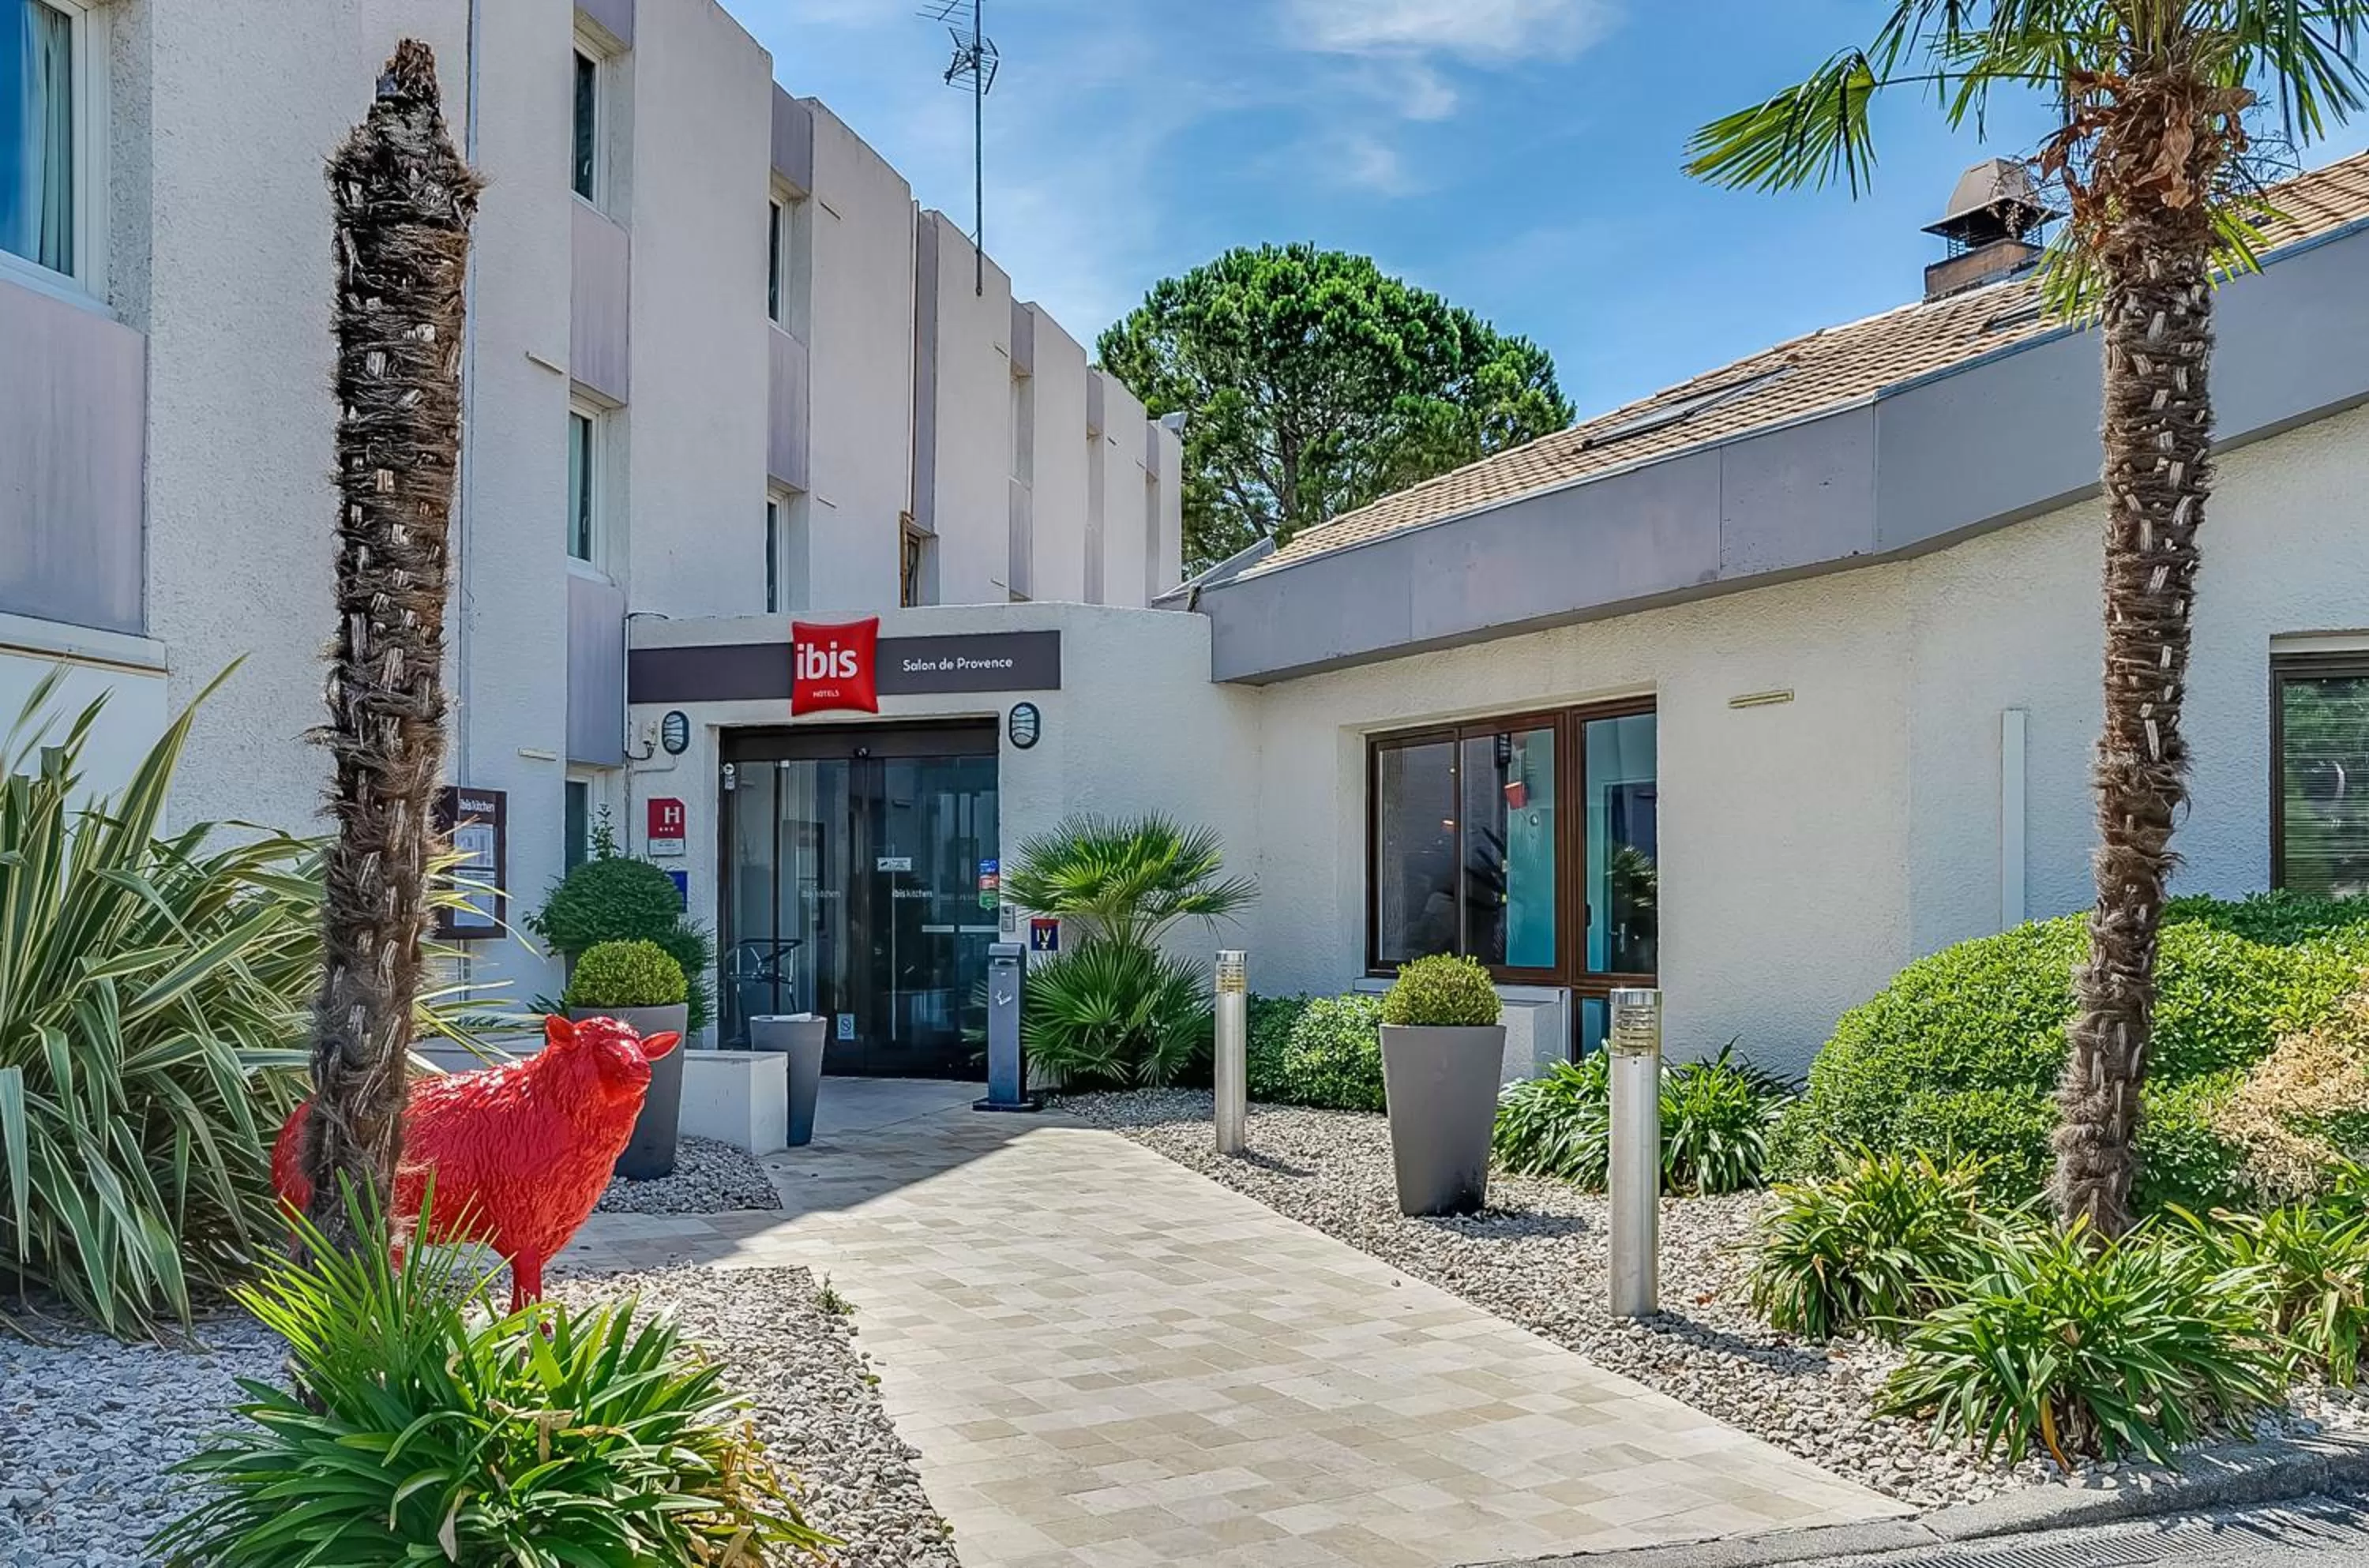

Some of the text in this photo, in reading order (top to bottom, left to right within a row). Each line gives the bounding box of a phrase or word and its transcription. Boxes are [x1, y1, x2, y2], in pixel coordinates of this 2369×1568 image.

[797, 641, 858, 680] ibis
[903, 656, 1013, 672] Salon de Provence
[664, 806, 681, 824] H
